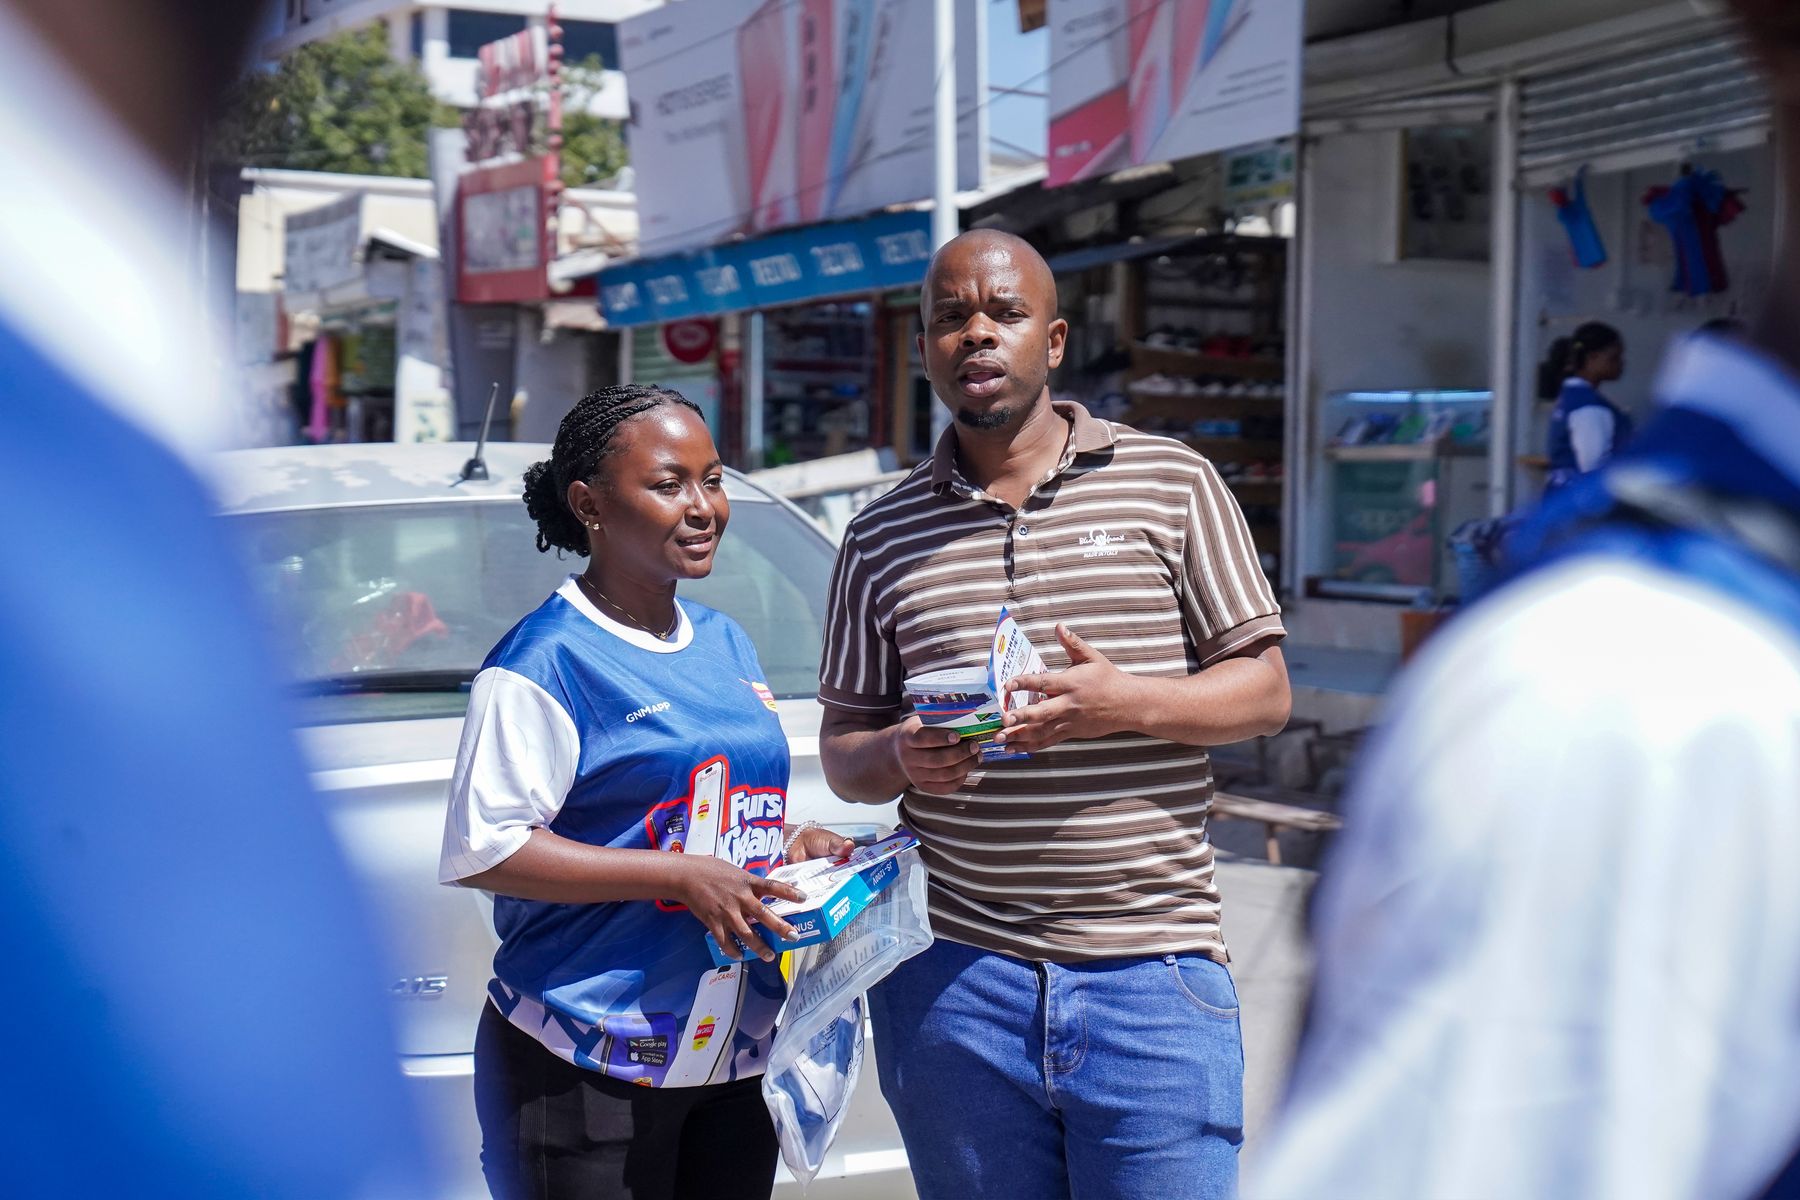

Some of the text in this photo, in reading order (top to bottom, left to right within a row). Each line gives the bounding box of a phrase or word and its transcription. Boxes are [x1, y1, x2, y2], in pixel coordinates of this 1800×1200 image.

[625, 701, 671, 723] GNM APP
[730, 791, 784, 828] Furs
[640, 1041, 657, 1049] Google
[641, 1055, 651, 1063] App
[651, 1056, 664, 1065] Store
